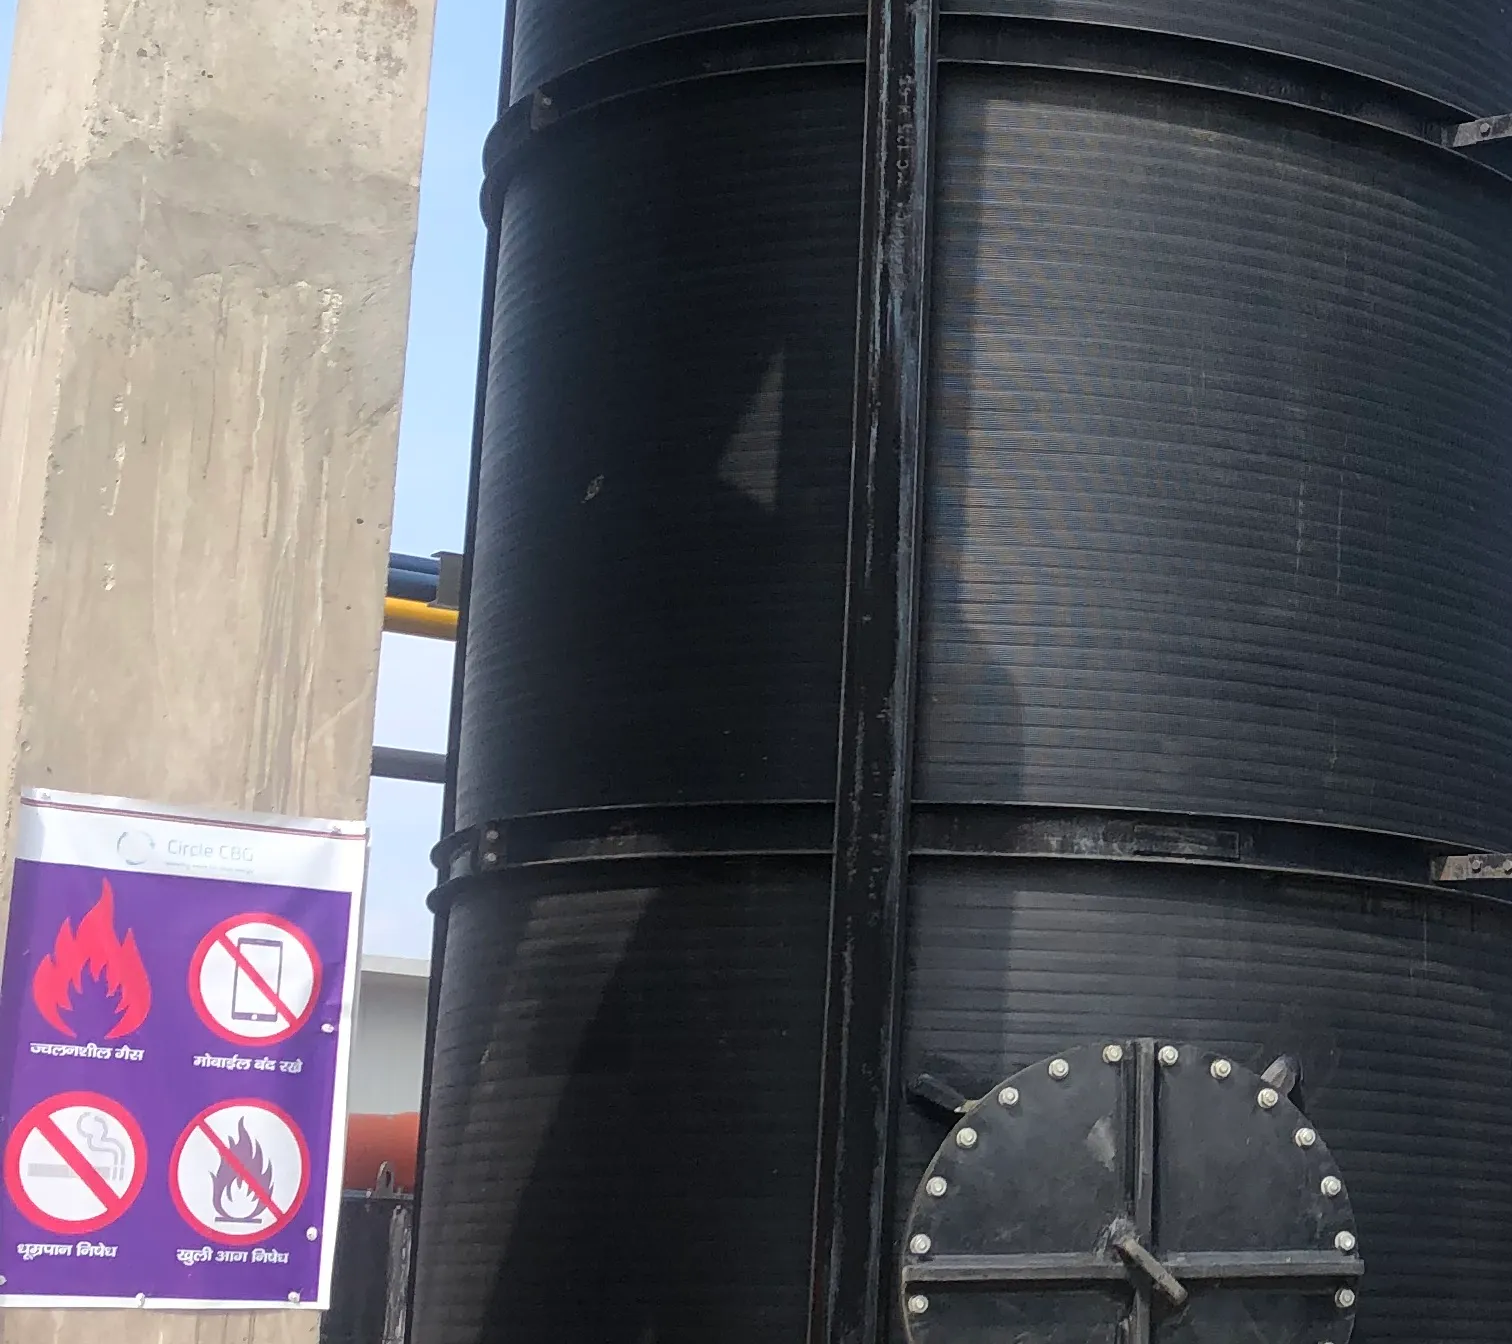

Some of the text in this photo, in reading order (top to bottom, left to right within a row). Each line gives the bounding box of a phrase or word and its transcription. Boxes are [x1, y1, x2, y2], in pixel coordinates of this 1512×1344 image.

[167, 839, 254, 862] Circle CBG
[176, 1246, 213, 1266] खुली
[215, 1250, 248, 1263] आग
